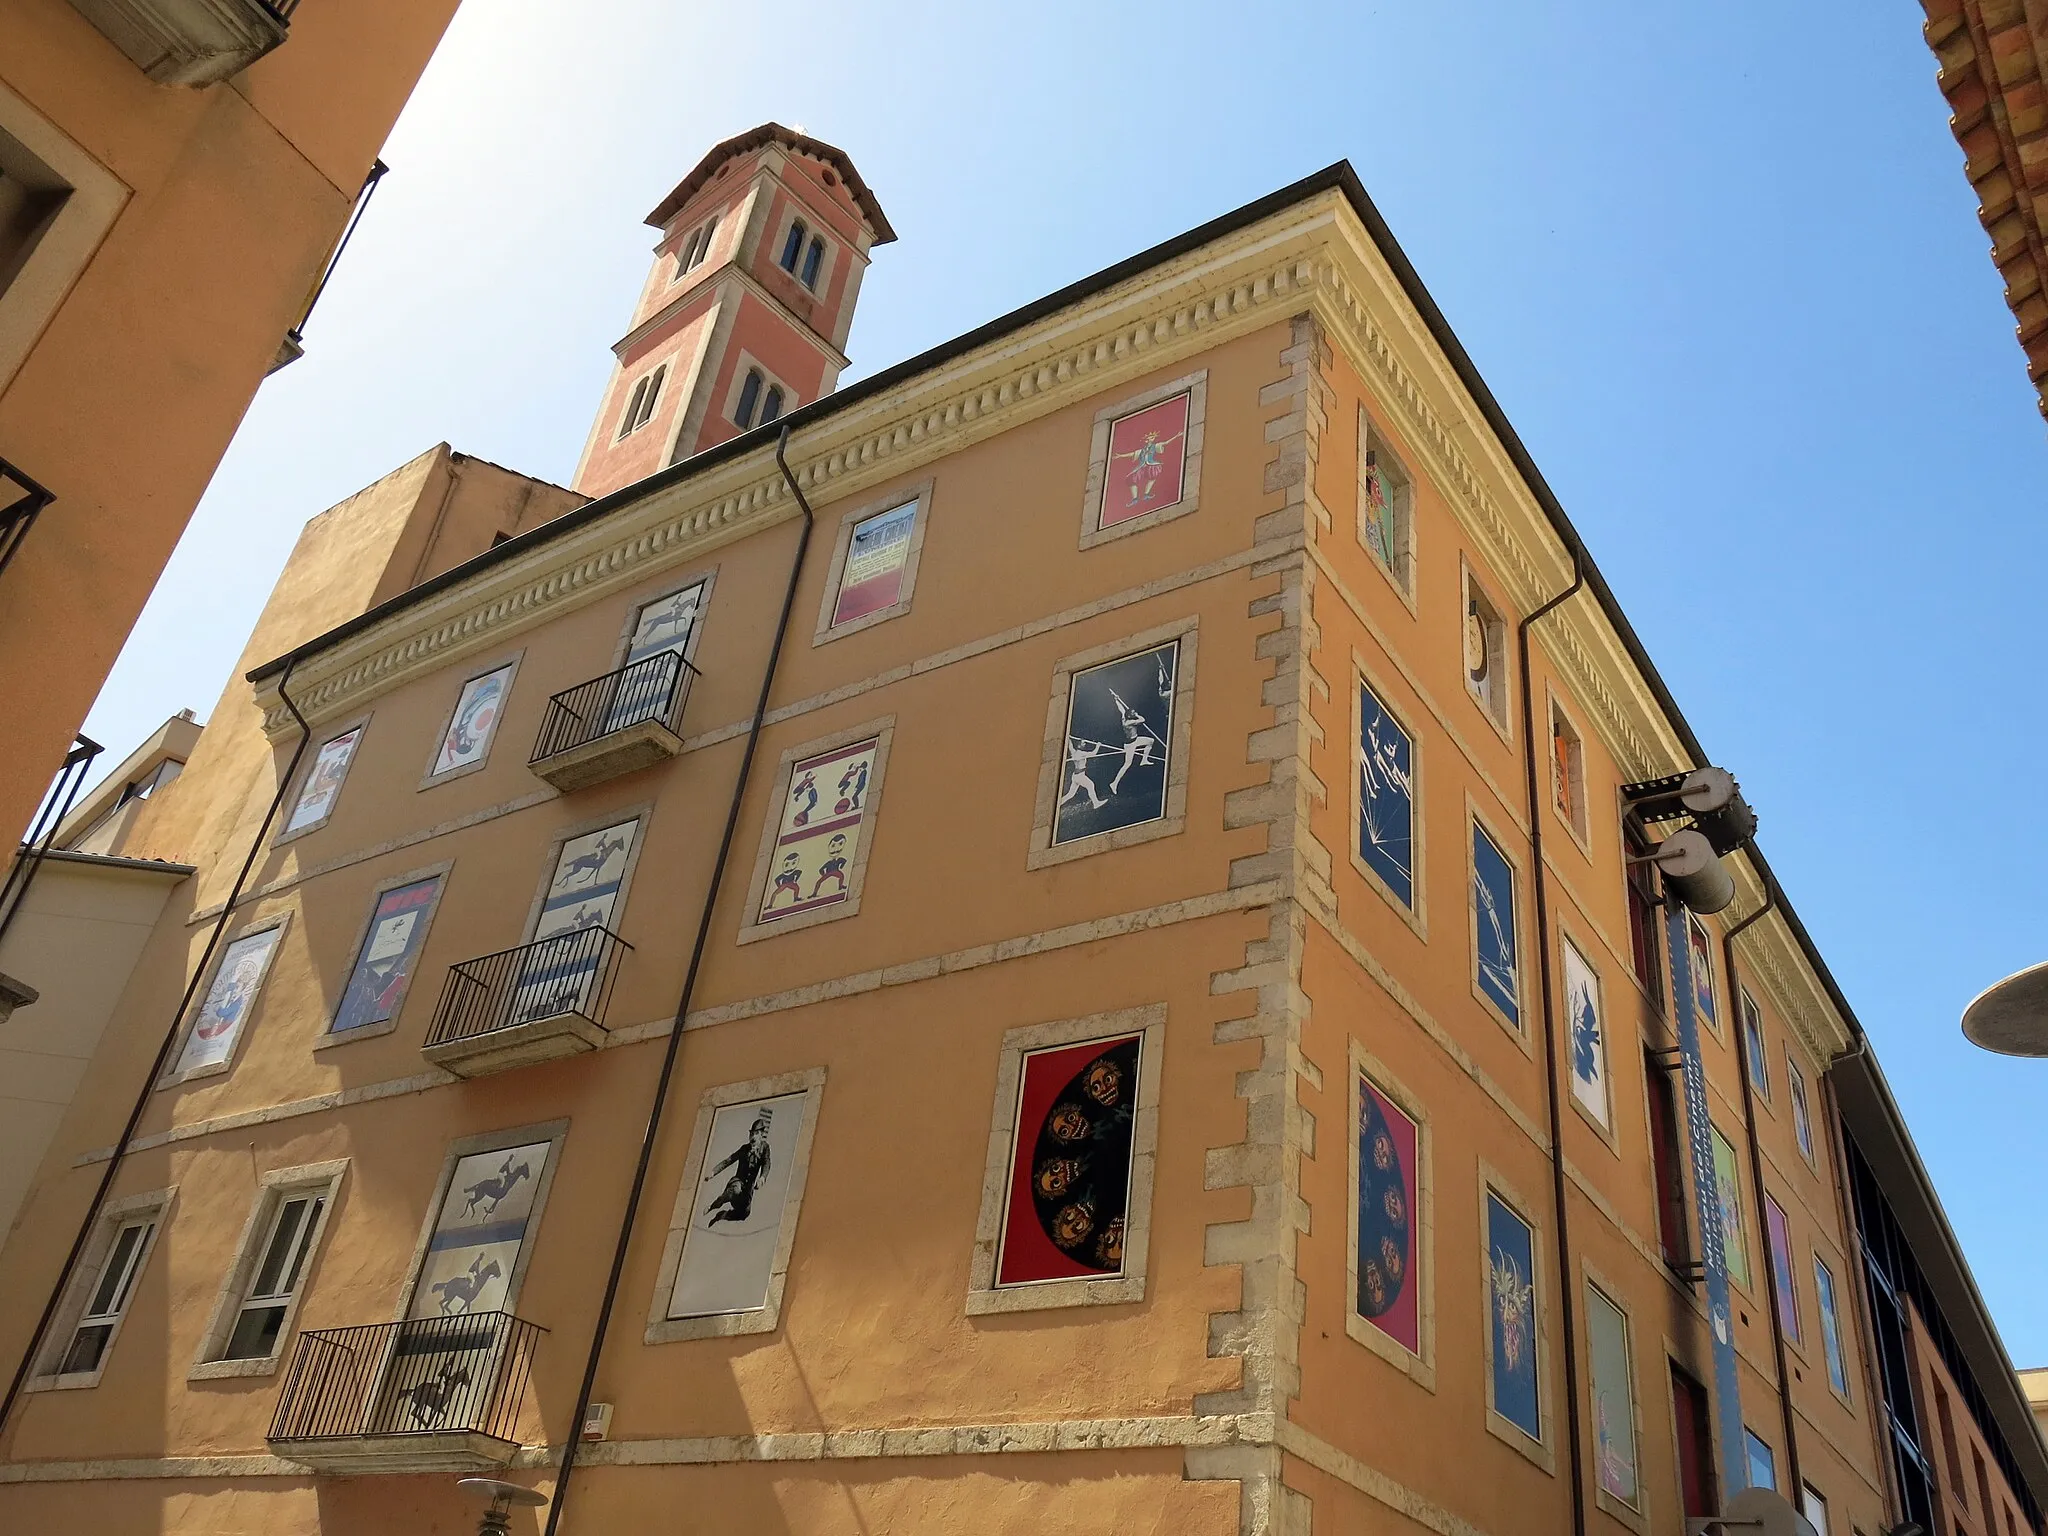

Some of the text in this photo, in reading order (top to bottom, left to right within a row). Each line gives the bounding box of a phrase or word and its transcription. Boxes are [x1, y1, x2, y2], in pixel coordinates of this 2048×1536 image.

[1693, 1059, 1705, 1116] Mallol
[1685, 1052, 1715, 1269] Museu del Cinema
